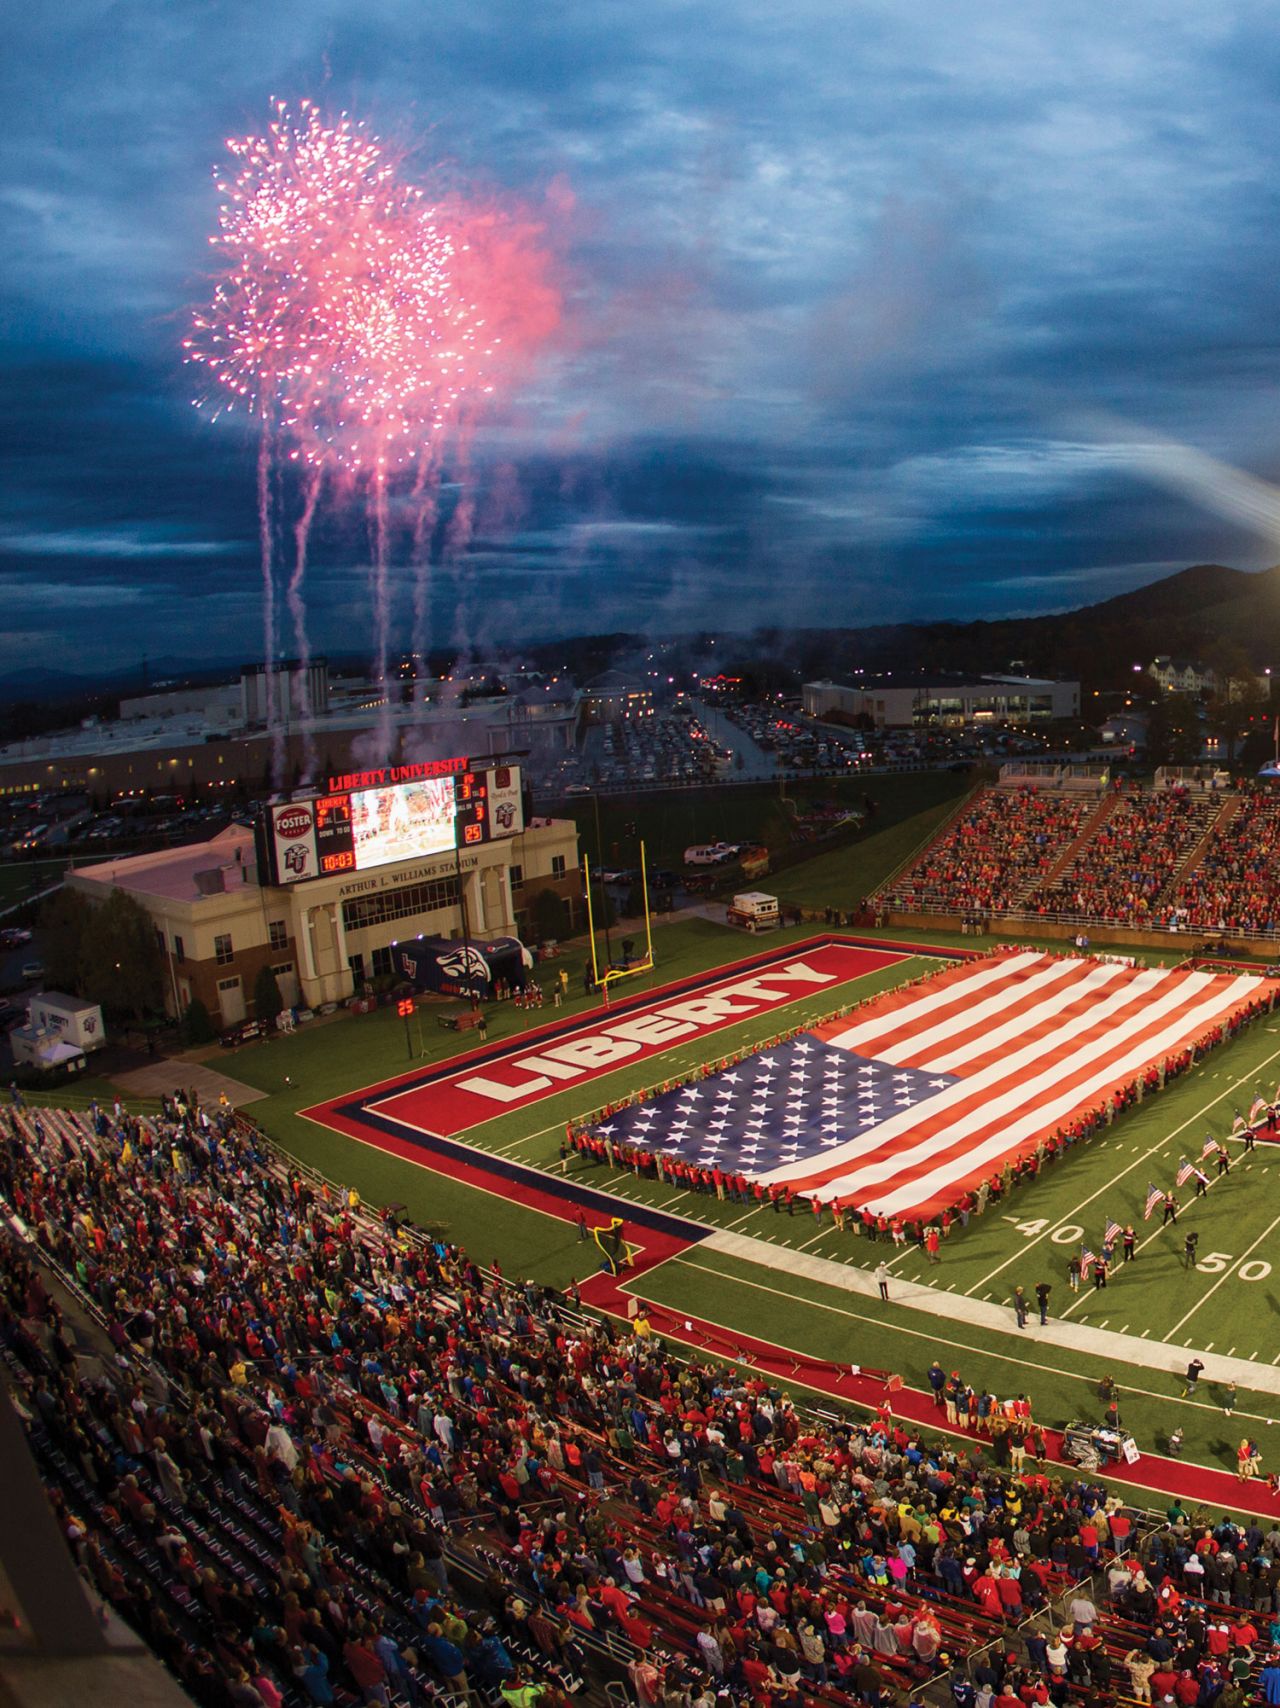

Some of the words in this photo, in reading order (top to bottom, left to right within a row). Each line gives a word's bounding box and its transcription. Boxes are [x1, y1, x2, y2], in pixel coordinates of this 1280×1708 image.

[329, 769, 387, 792] LIBERTY
[390, 757, 469, 781] UNIVERSITY
[316, 795, 349, 810] LIBERTY
[341, 806, 349, 819] 7
[476, 807, 484, 820] 3
[276, 815, 311, 830] FOSTER
[466, 826, 480, 841] 25
[324, 853, 353, 870] 10:03
[339, 880, 377, 897] ARTHUR
[392, 866, 438, 884] WILLIAMS
[397, 1000, 414, 1016] 25
[453, 962, 839, 1103] LIBERTY
[1014, 1218, 1084, 1244] 40
[1195, 1251, 1272, 1281] 50
